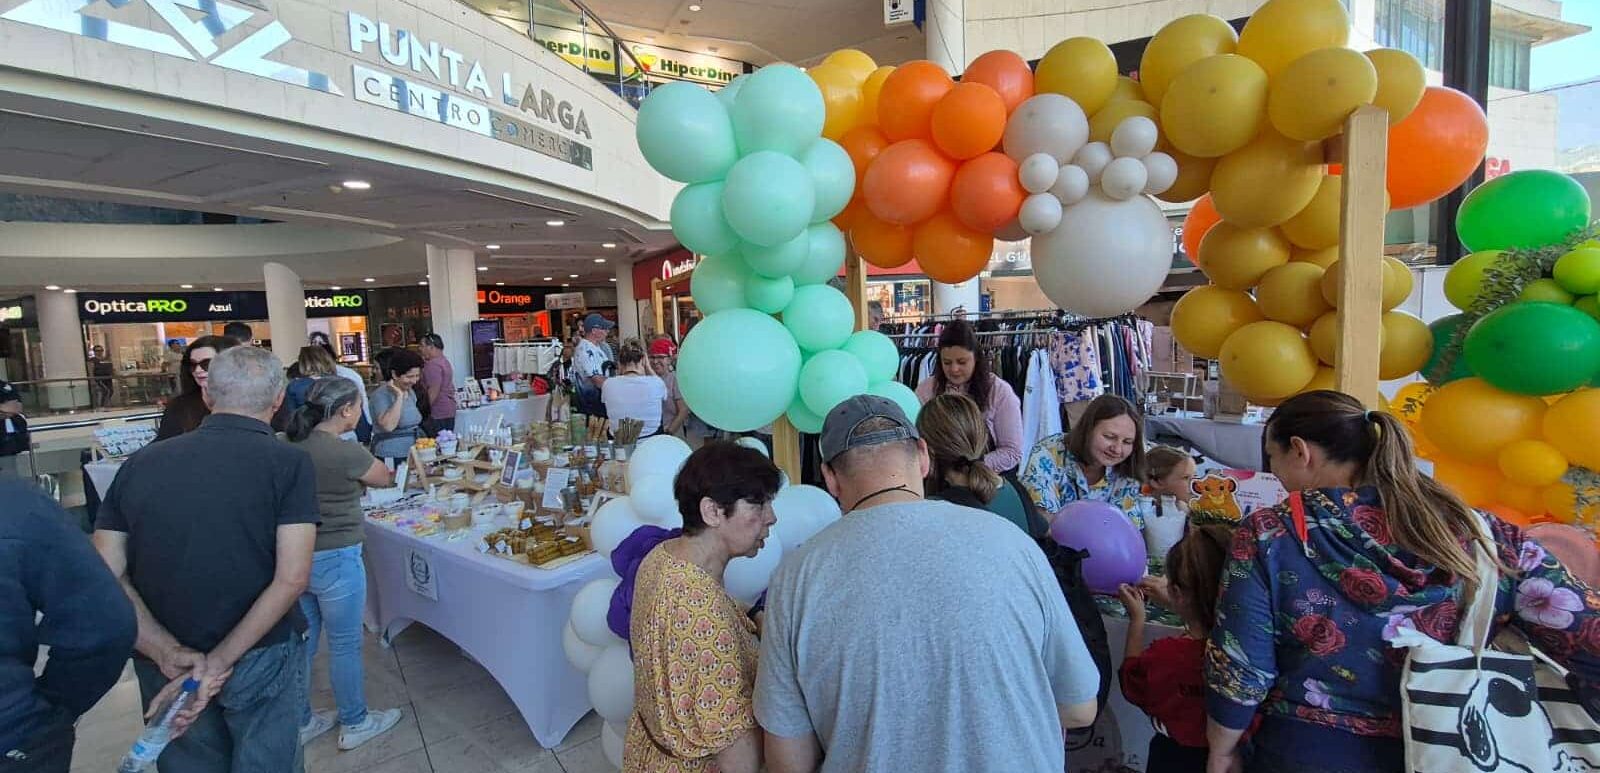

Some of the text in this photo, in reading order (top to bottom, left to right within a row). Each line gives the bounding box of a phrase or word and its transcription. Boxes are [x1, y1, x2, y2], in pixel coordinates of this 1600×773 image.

[347, 10, 592, 139] PUNTA LARGA
[363, 77, 481, 125] CENTRO
[85, 299, 232, 315] OpticaPRO Azul
[489, 290, 532, 306] Orange
